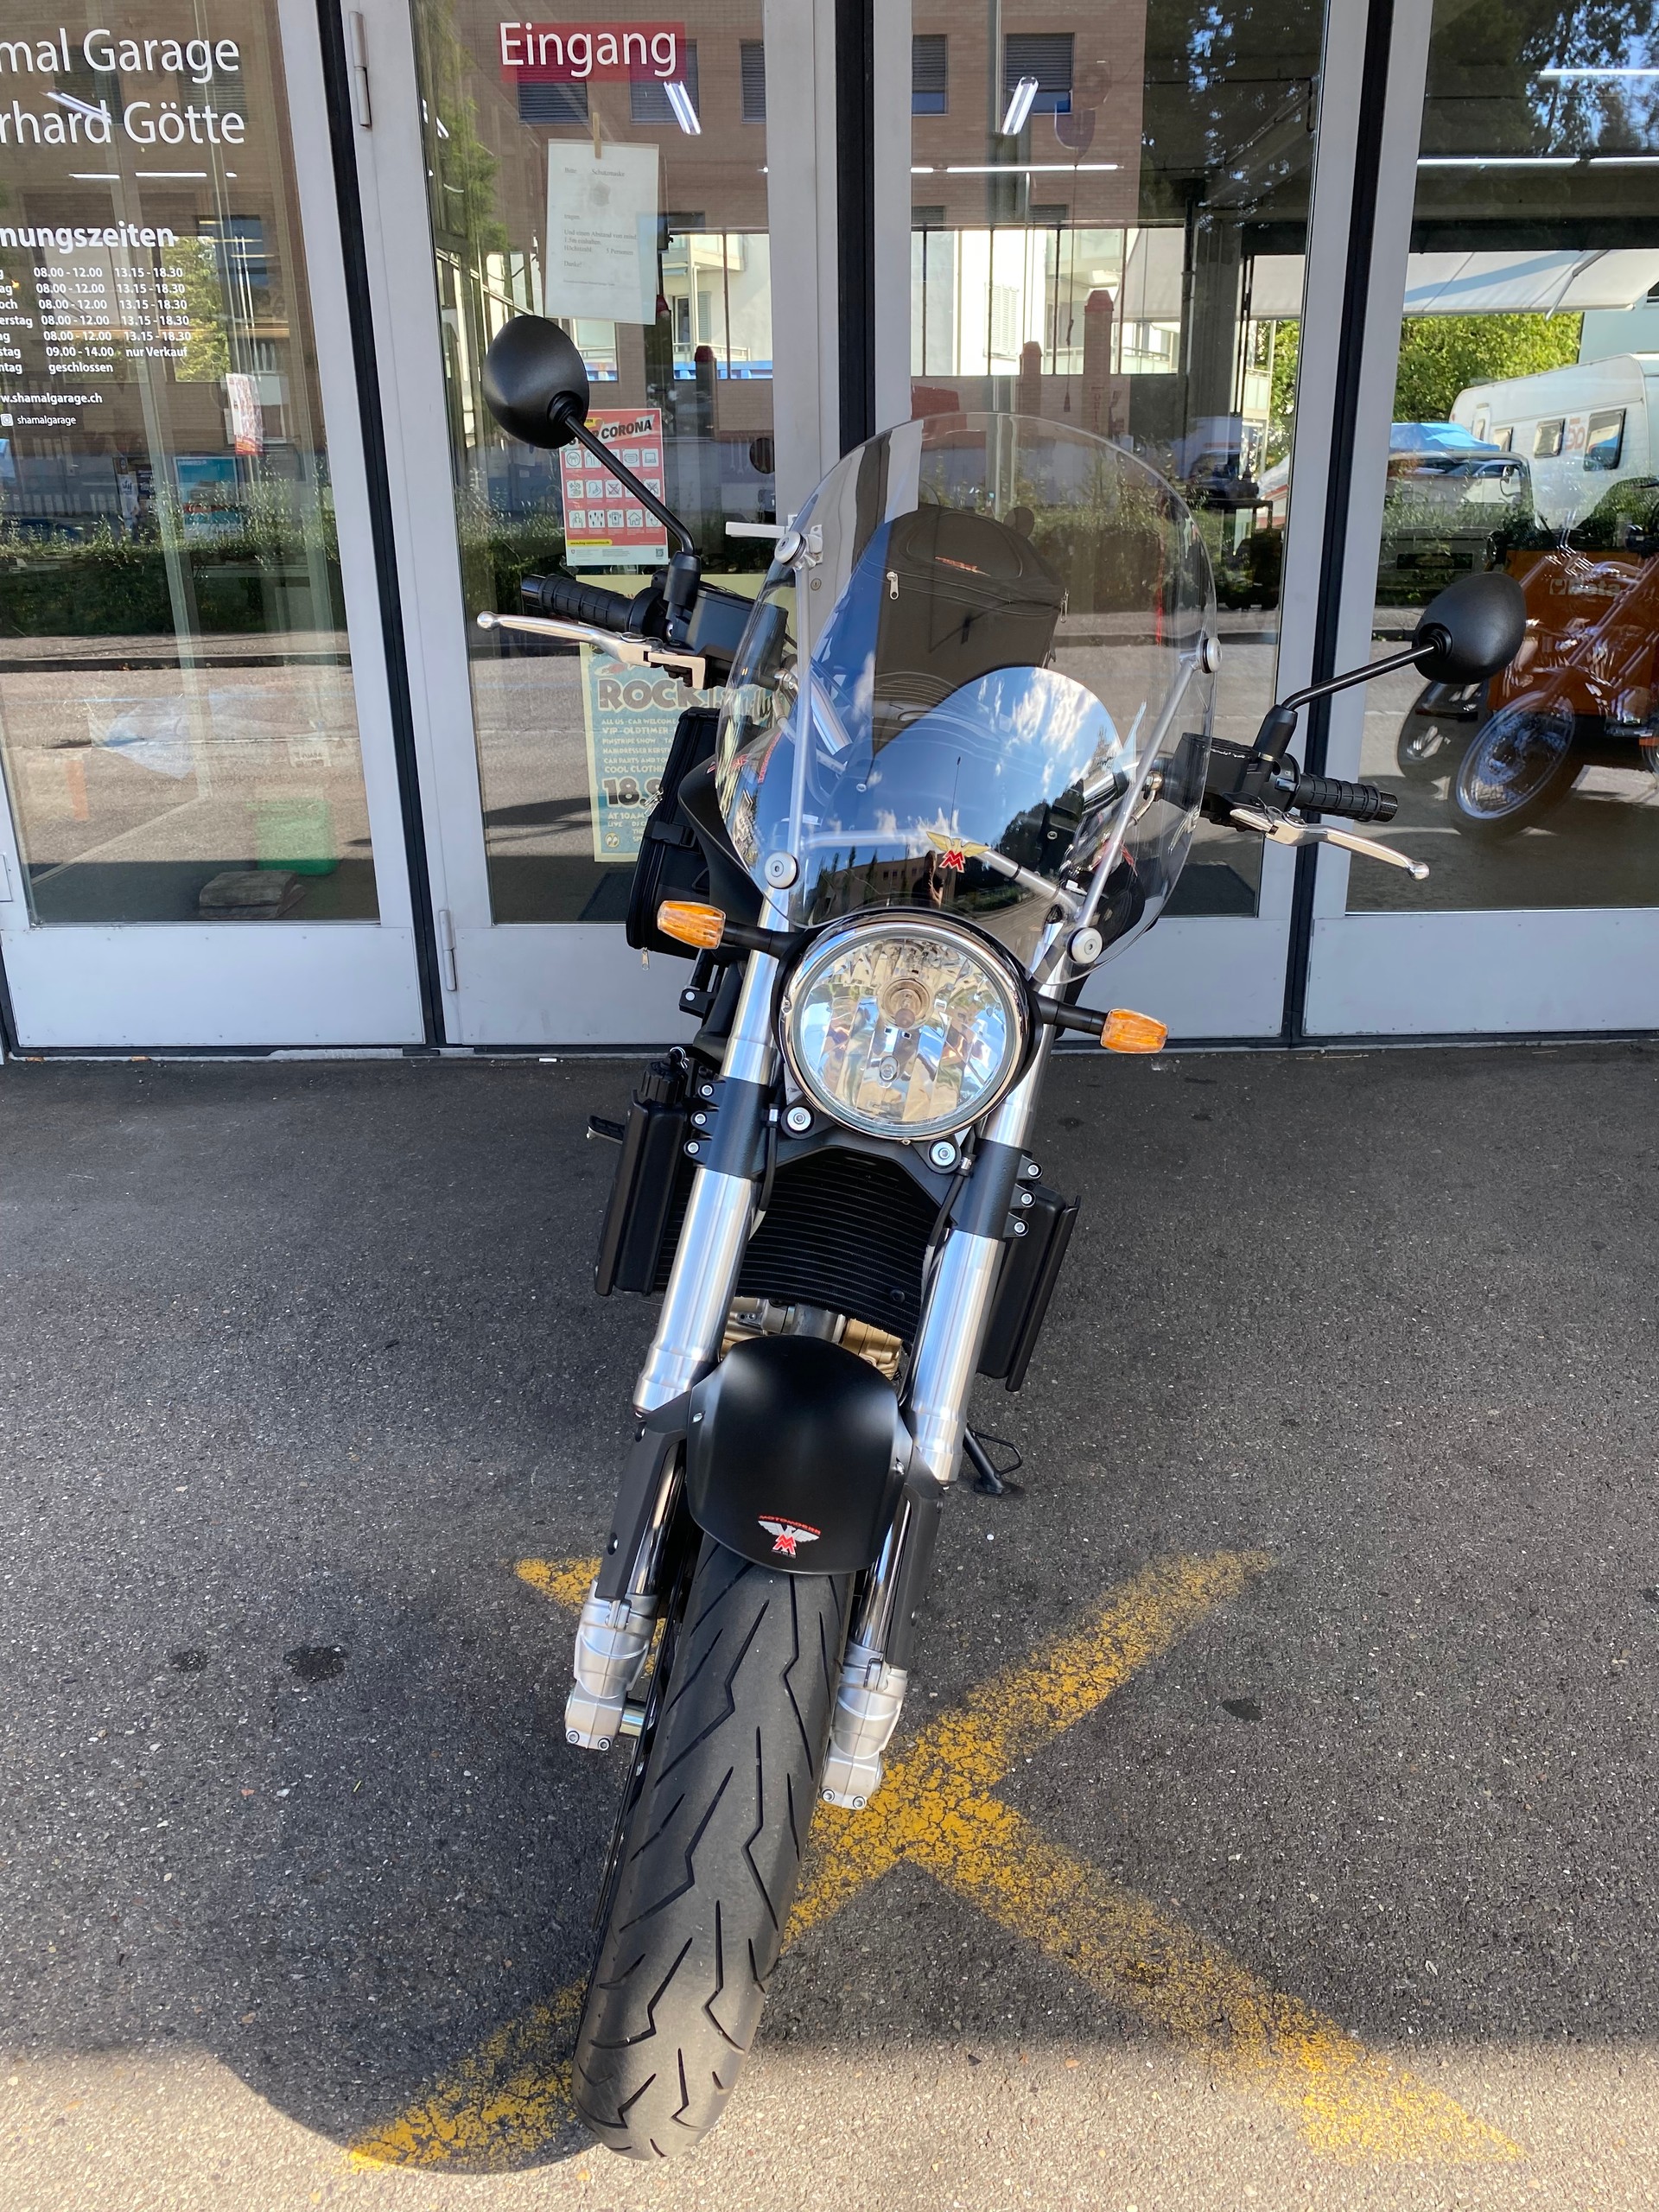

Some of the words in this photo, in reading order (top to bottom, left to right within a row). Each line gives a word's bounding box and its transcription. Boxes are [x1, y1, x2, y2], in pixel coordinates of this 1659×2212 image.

[499, 22, 677, 77] Eingang
[83, 29, 239, 83] Garage
[124, 101, 245, 143] Götte
[33, 267, 65, 277] 08.00
[73, 267, 103, 277] 12.00
[114, 267, 145, 277] 13.15
[153, 267, 183, 277] 18.30
[35, 283, 67, 294] 08.00
[74, 283, 105, 294] 12.00
[117, 283, 147, 294] 13.15
[155, 283, 186, 294] 18.30
[38, 299, 69, 309] 08.00
[77, 299, 107, 309] 12.00
[119, 299, 149, 309] 13.15
[157, 299, 188, 309] 18.30
[41, 315, 72, 326] 08.00
[79, 315, 110, 326] 12.00
[121, 315, 151, 326] 13.15
[159, 315, 189, 326] 18.30
[43, 331, 74, 341] 08.00
[82, 331, 112, 341] 12.00
[124, 331, 154, 341] 13.15
[162, 331, 192, 341] 18.30
[46, 346, 76, 357] 09.00
[85, 346, 115, 357] 14.00
[125, 348, 144, 357] nur
[145, 346, 188, 357] Verkauf
[48, 363, 113, 375] geschlossen
[16, 415, 77, 427] shamalgarage
[601, 419, 652, 440] CORONA
[598, 678, 704, 711] ROCK
